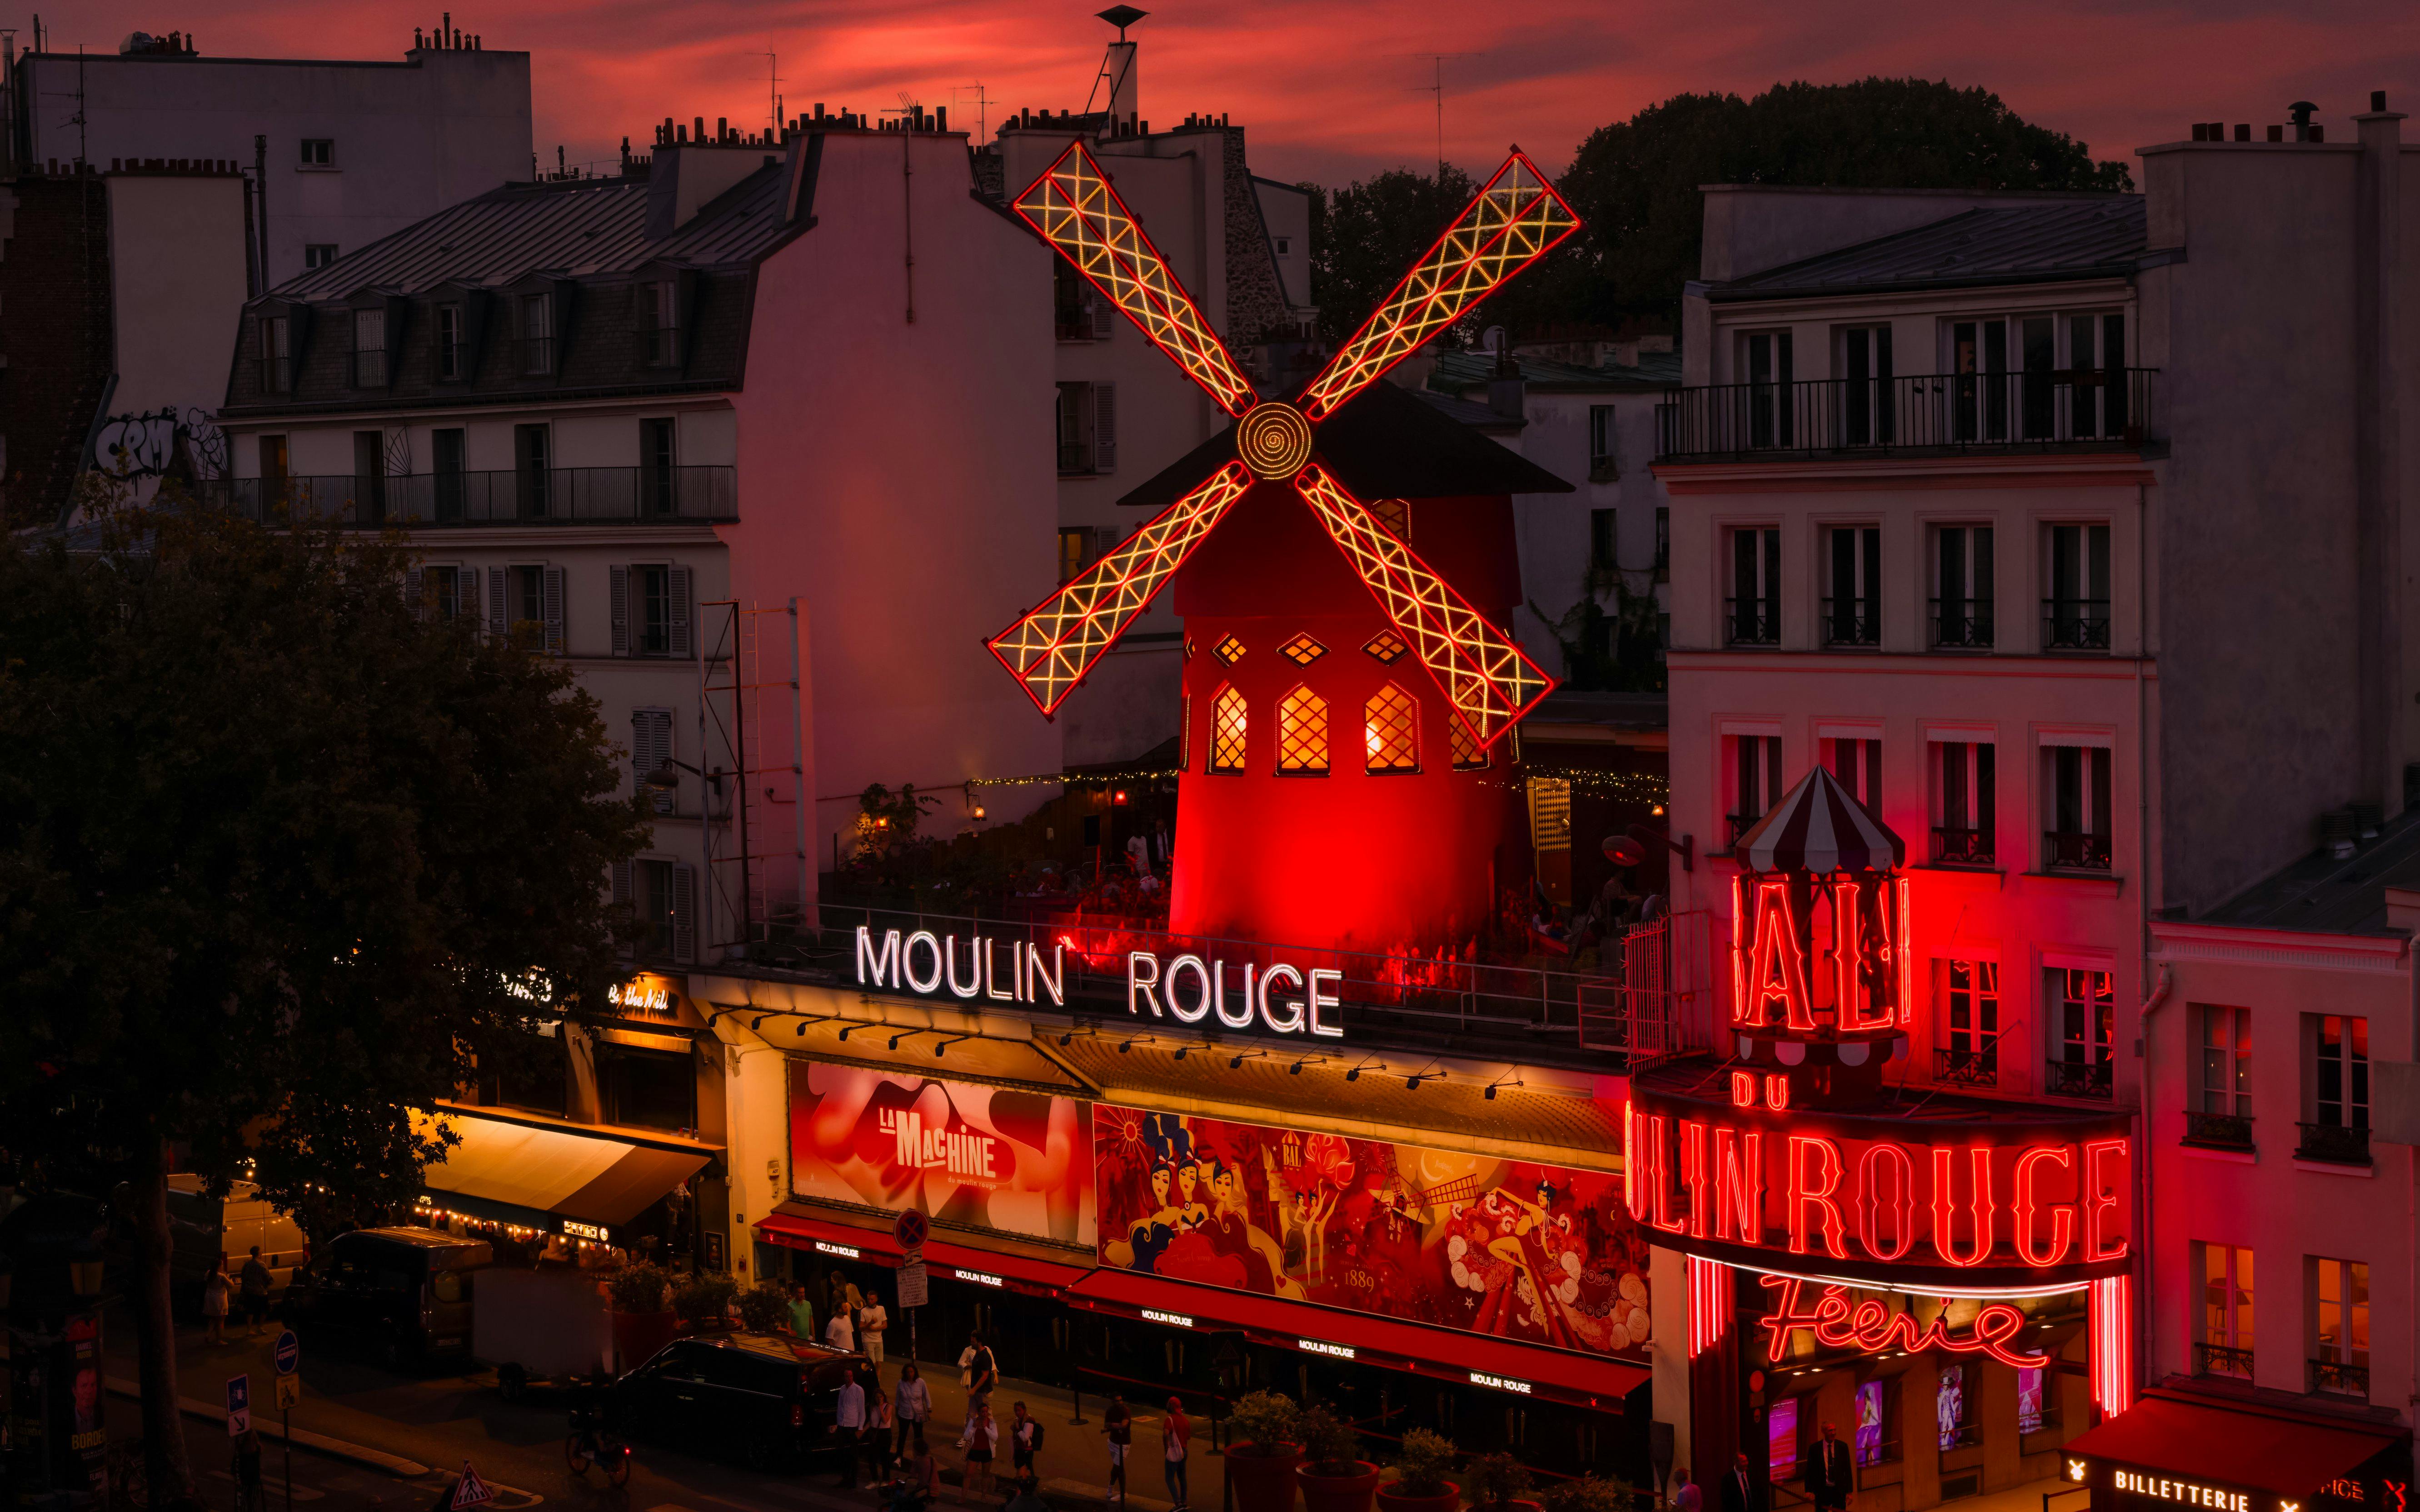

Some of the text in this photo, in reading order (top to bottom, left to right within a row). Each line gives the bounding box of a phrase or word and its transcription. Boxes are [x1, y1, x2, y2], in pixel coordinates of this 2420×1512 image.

[857, 925, 1343, 1037] MOULIN ROUGE
[624, 985, 644, 1007] the
[1733, 1072, 1788, 1110] DU
[879, 1107, 895, 1129] LA
[1282, 1144, 1302, 1167] BAL
[957, 1178, 977, 1187] moulin
[978, 1181, 997, 1190] rouge
[1788, 1136, 2129, 1268] ROUGE
[838, 1246, 859, 1258] ROUGE
[955, 1269, 1003, 1287] MOULIN ROUGE
[1345, 1269, 1375, 1293] 1889
[1142, 1310, 1193, 1327] MOULIN ROUGE
[1299, 1339, 1355, 1358] MOULIN ROUGE
[1470, 1373, 1531, 1394] MOULIN ROUGE
[2116, 1470, 2248, 1512] BILLETTERIE
